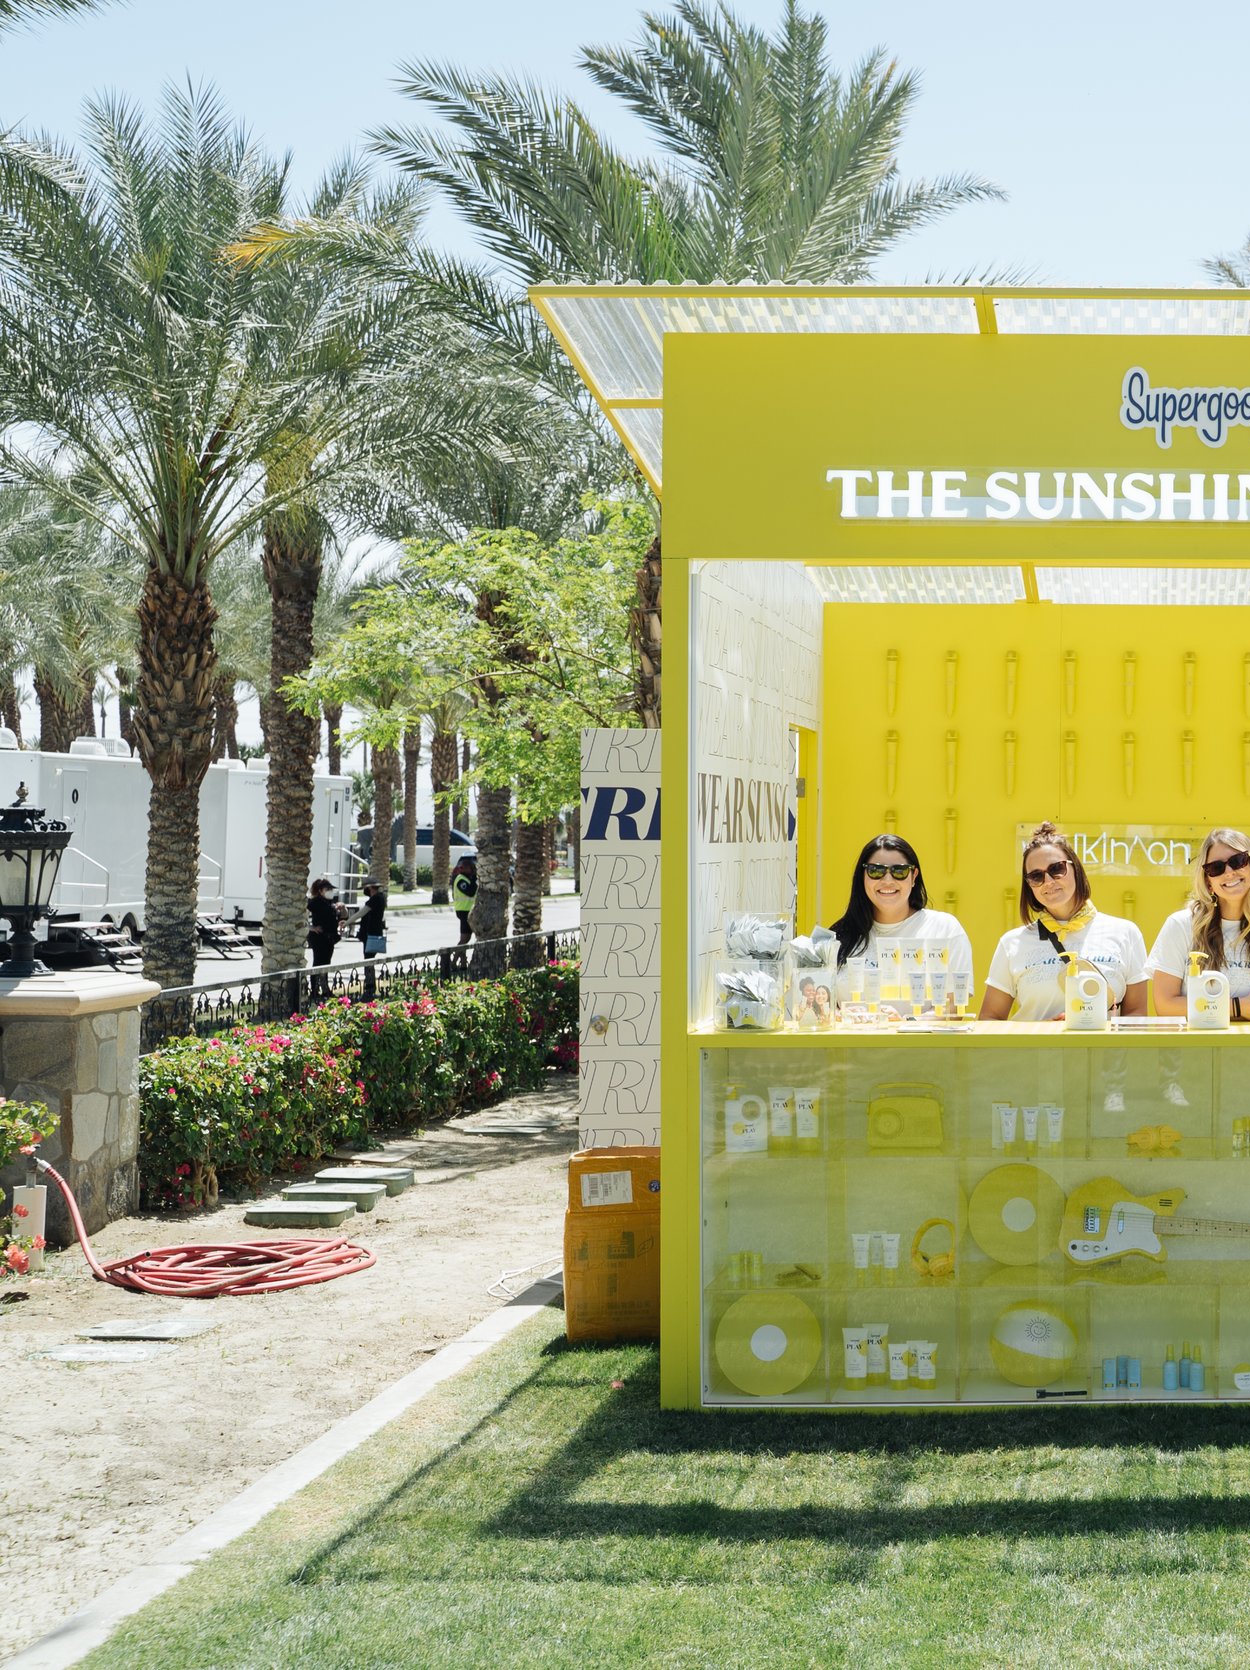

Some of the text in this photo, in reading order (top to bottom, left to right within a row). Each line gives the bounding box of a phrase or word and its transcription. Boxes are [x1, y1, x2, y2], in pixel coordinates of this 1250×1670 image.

[826, 470, 967, 518] THE
[697, 772, 744, 843] WEAR
[1147, 839, 1191, 866] on
[772, 1101, 789, 1109] PLAY
